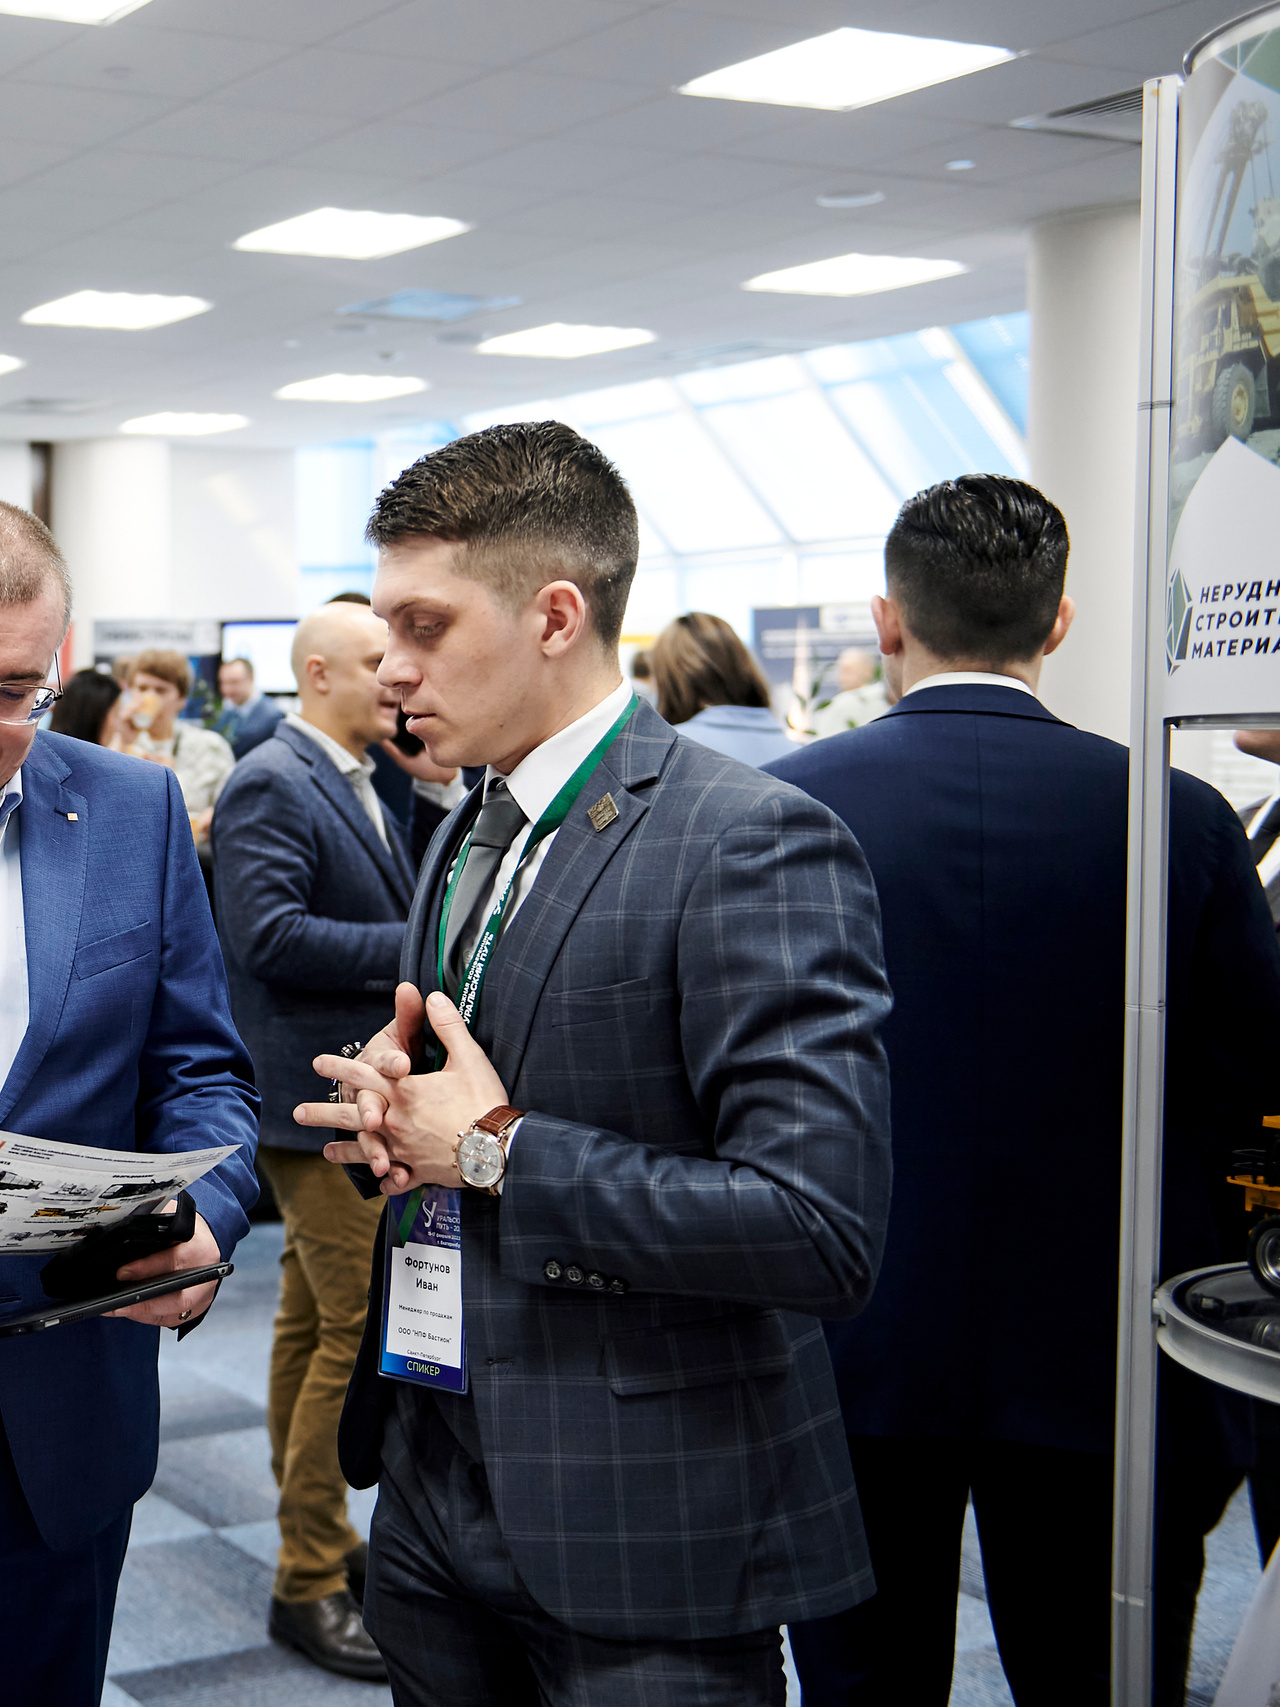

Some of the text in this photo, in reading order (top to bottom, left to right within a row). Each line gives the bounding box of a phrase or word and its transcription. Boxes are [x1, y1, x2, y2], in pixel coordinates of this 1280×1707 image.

[1200, 579, 1280, 604] НЕРУДН
[1196, 608, 1280, 632] СТРОИТ
[463, 933, 494, 1024] УРАЛЬСКИЙ ПУТЬ
[459, 982, 471, 1015] ОРОЖНАЯ
[404, 1256, 451, 1274] Фортунов
[416, 1277, 438, 1292] Иван
[398, 1304, 422, 1315] Менеджер
[430, 1311, 453, 1320] продажам
[398, 1326, 411, 1335] ООО
[427, 1333, 452, 1343] Бастион"
[406, 1349, 441, 1362] Санкт-Петербург
[406, 1360, 441, 1376] СПИКЕР
